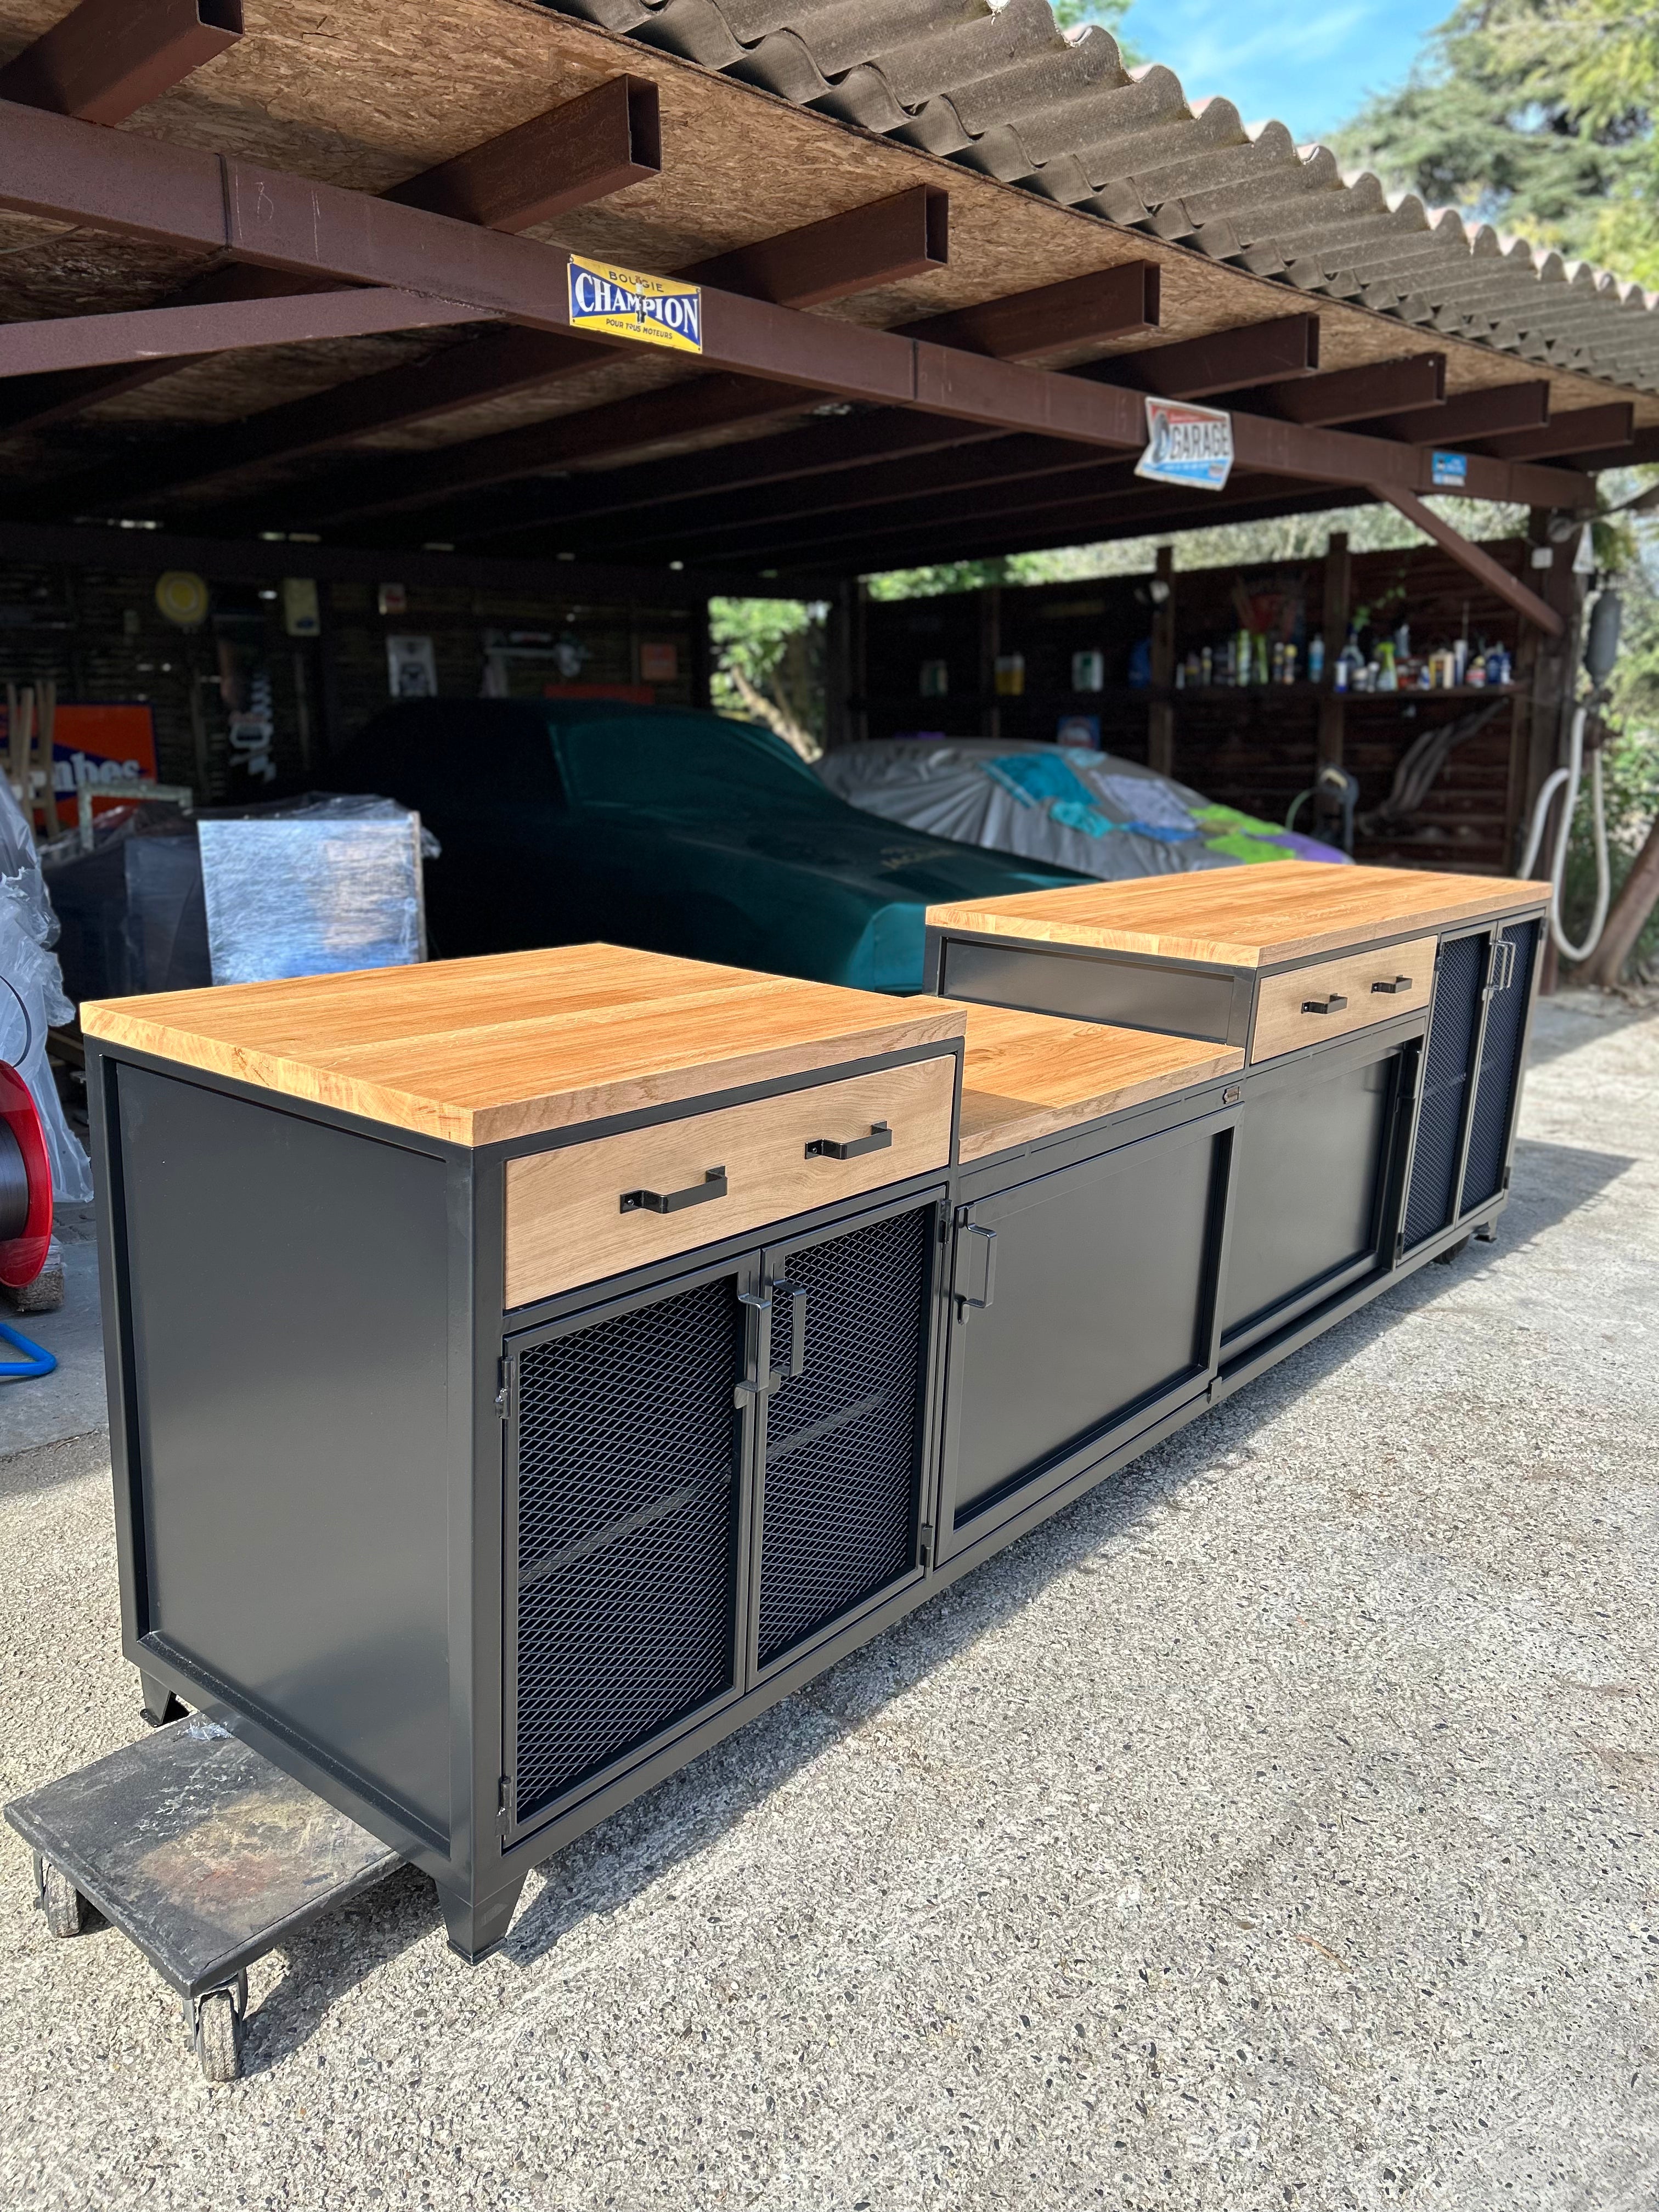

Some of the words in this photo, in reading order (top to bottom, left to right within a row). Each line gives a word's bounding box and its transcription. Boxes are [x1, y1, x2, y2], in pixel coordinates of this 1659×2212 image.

[608, 270, 664, 292] BOUGIE
[575, 272, 698, 338] CHAMPION
[606, 318, 623, 329] POUR
[643, 327, 673, 339] MOTEURS
[1170, 423, 1229, 459] GARAGE
